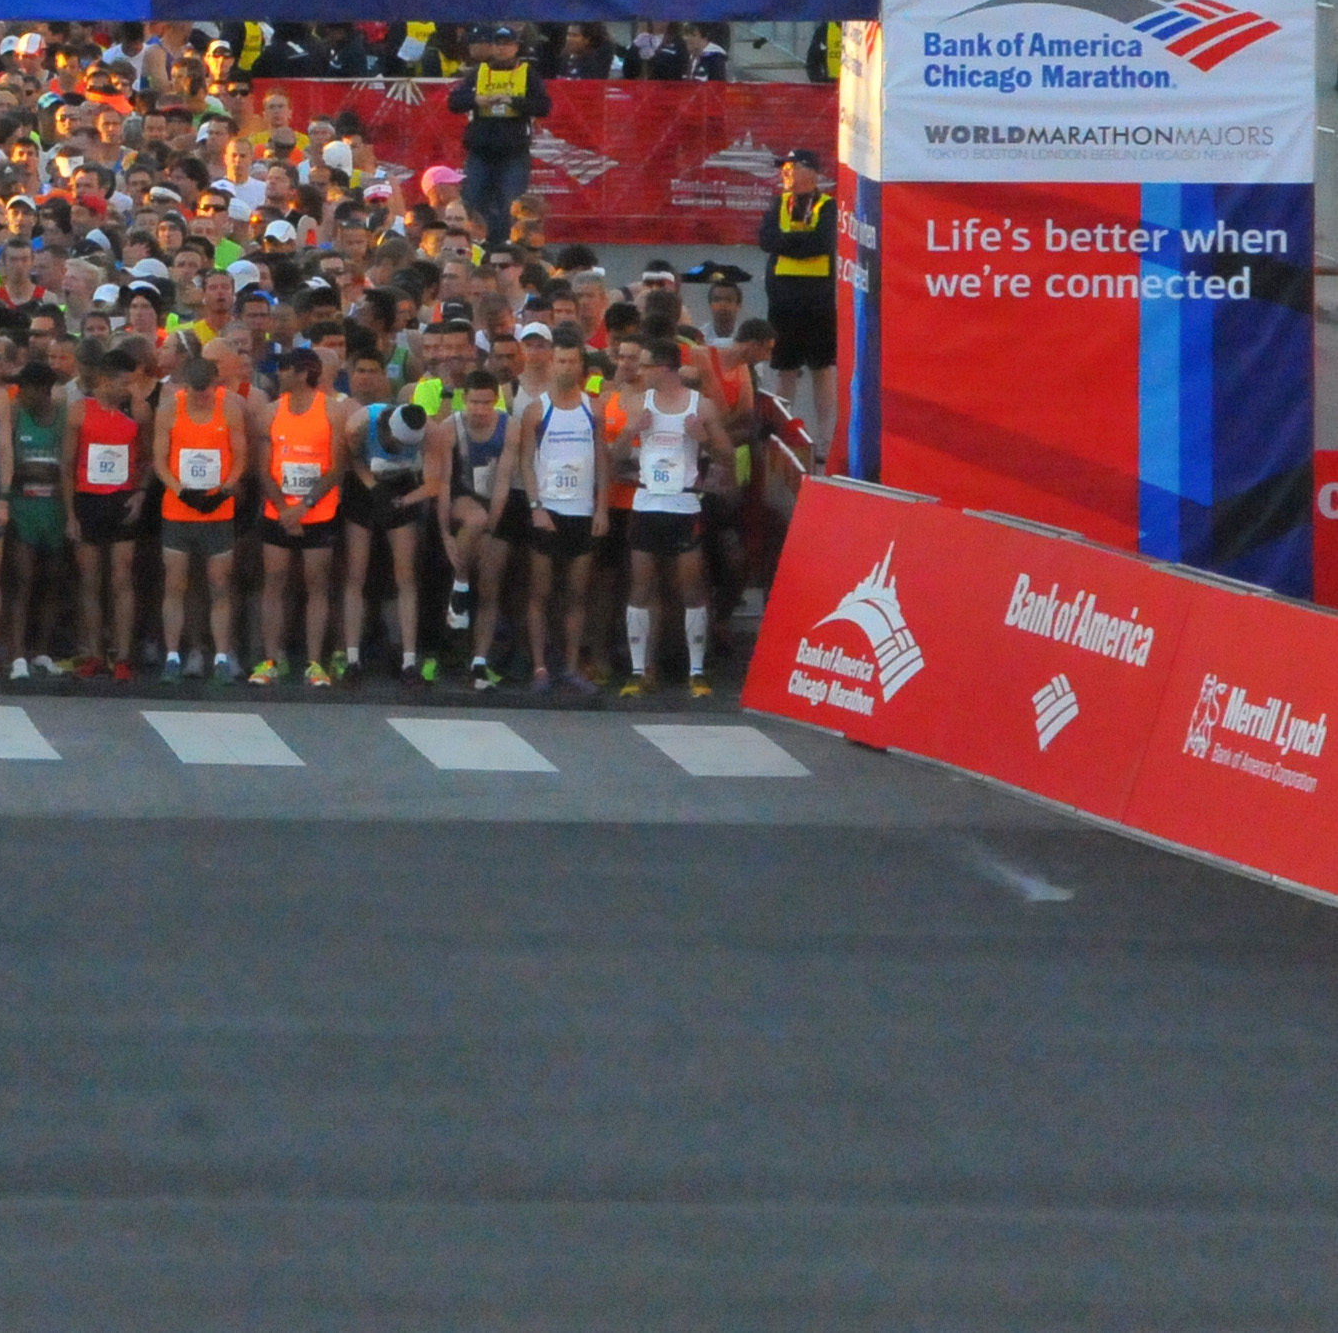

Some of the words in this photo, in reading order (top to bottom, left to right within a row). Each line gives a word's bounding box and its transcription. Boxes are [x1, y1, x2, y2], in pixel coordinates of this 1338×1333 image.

[924, 32, 992, 57] Bank
[996, 31, 1026, 57] of
[1029, 32, 1143, 57] America
[924, 64, 1031, 93] Chicago
[925, 124, 1275, 147] WORLDMARATHONMAJORS
[926, 148, 968, 160] TOKYO
[972, 148, 1029, 160] BOSTON
[1031, 148, 1088, 160] LONDON
[1091, 148, 1137, 160] BERLIN
[1139, 148, 1200, 160] CHICAGO
[1203, 148, 1236, 160] NEW
[1238, 148, 1274, 160] YORK
[926, 218, 1031, 253] Life's
[1045, 218, 1169, 253] better
[1182, 220, 1288, 253] when
[925, 265, 1031, 299] we're
[1045, 267, 1251, 299] connected
[99, 461, 116, 474] 92
[190, 465, 207, 478] 65
[555, 475, 578, 489] 310
[1005, 572, 1060, 638] Bank
[1053, 589, 1086, 645] of
[1074, 592, 1155, 668] America
[795, 637, 824, 669] Bank
[820, 645, 839, 672] of
[831, 646, 875, 683] America
[787, 669, 828, 706] Chicago
[826, 679, 875, 716] Marathon
[1222, 686, 1281, 742] Merrill
[1275, 701, 1328, 757] Lynch
[1211, 742, 1234, 769] Bank
[1240, 752, 1274, 781] America
[1270, 761, 1318, 794] Corporation
